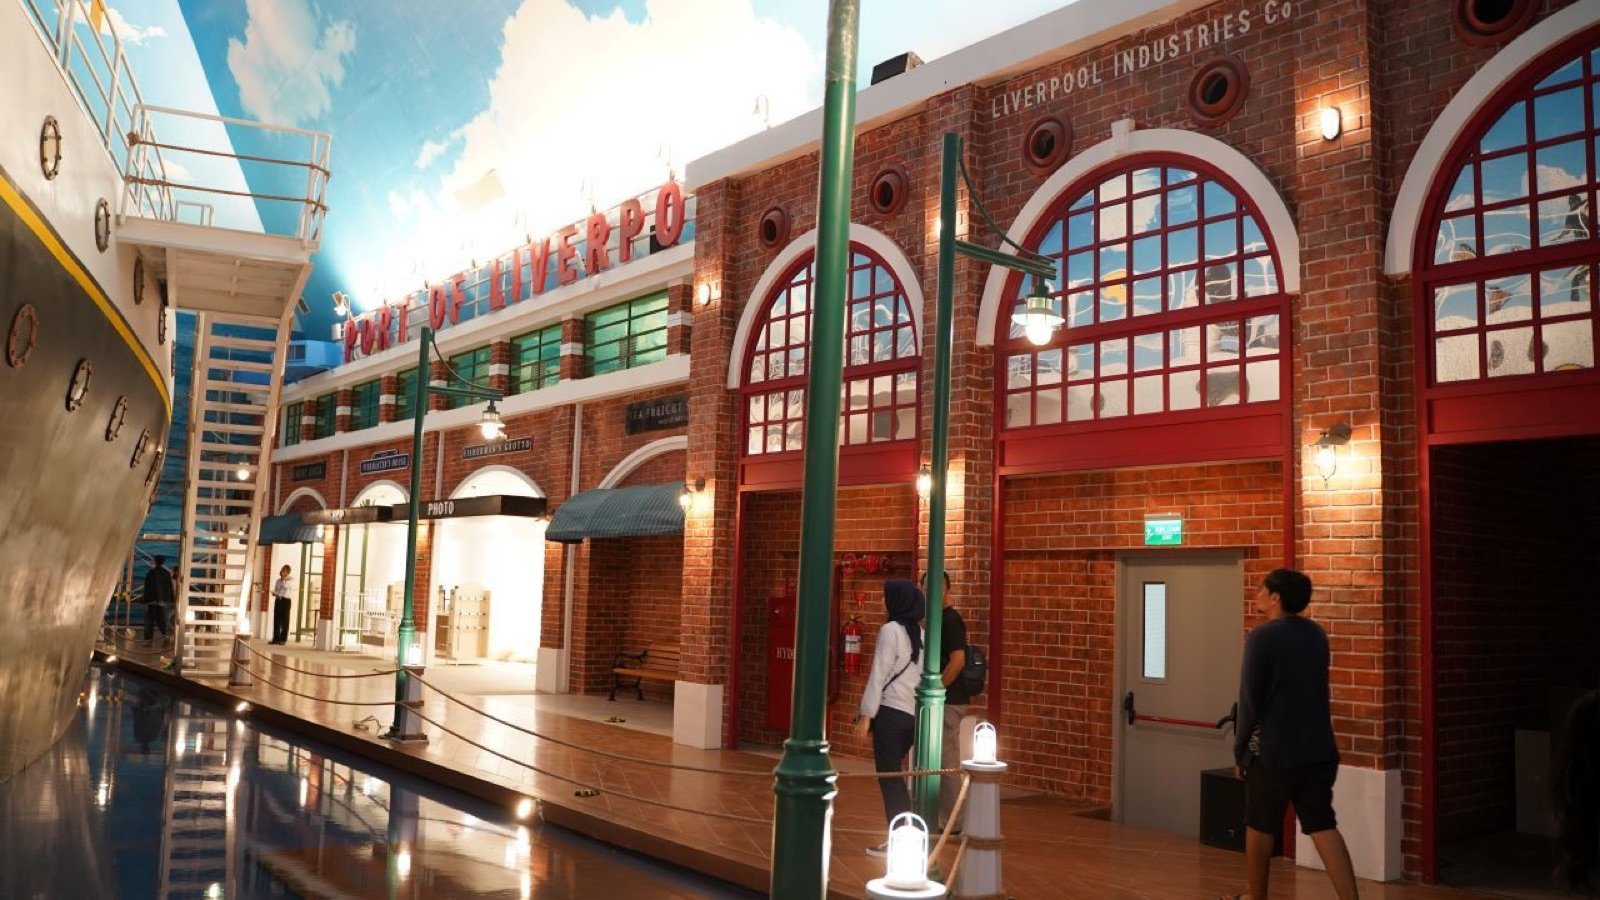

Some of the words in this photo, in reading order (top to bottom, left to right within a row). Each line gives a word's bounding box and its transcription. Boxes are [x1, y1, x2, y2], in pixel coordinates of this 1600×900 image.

[991, 65, 1102, 119] LIVERPOOL
[1113, 9, 1251, 78] INDUSTRIES
[344, 294, 410, 363] PORT
[428, 272, 467, 331] OF
[489, 180, 687, 311] LIVERPO
[428, 501, 455, 515] PHOTO
